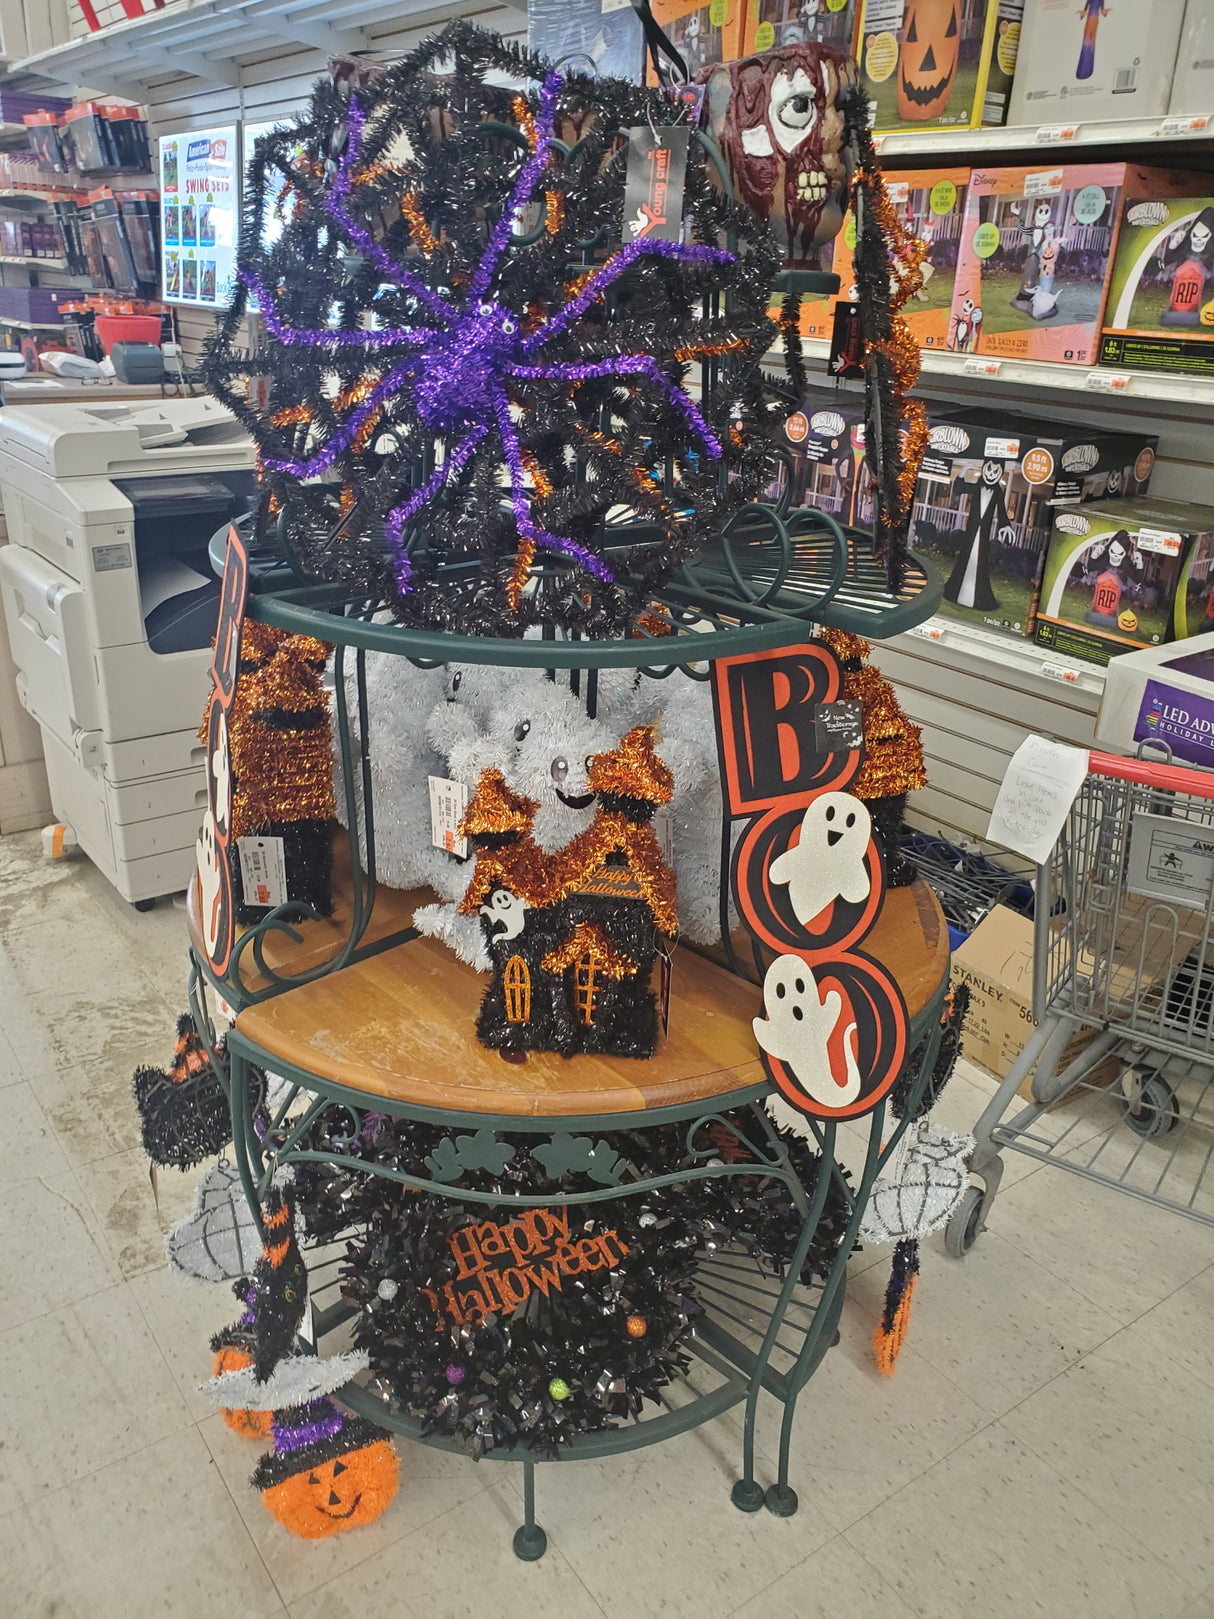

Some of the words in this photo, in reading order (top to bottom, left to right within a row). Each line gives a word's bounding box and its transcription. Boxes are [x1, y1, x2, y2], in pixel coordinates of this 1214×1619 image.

[186, 178, 210, 194] SWING
[973, 173, 998, 189] Disney
[640, 181, 668, 238] Young
[655, 149, 668, 179] craft
[1175, 281, 1199, 304] RIP
[1031, 453, 1040, 461] 9.5
[1040, 455, 1047, 463] ft
[1097, 589, 1117, 609] RIP
[1163, 704, 1189, 725] LED
[1160, 720, 1204, 742] HOLIDAY
[593, 866, 633, 886] Happy
[952, 965, 1004, 1003] STANLEY
[449, 1205, 569, 1281] Happy
